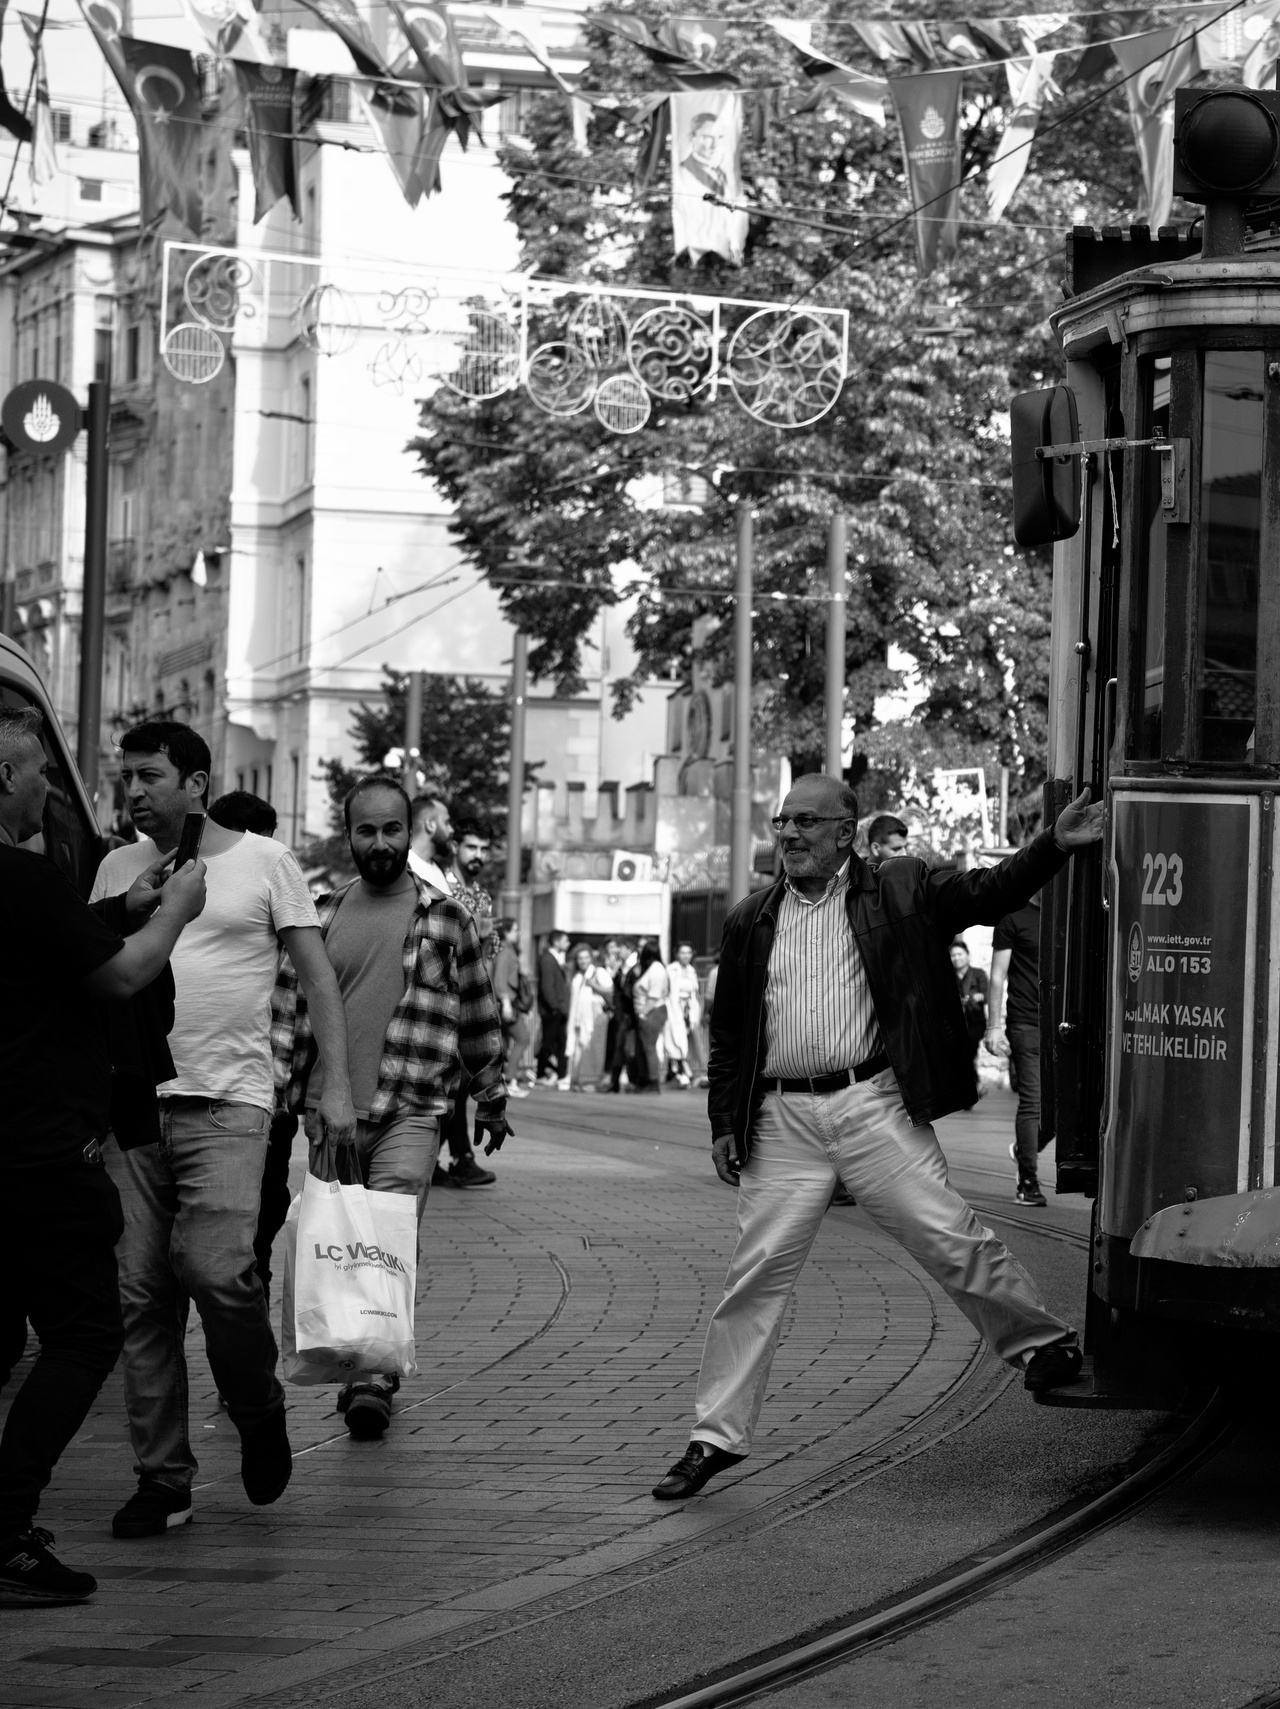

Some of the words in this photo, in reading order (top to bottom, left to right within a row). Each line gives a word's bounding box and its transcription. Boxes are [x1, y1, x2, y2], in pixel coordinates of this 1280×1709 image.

[1141, 852, 1183, 906] 223
[1147, 934, 1212, 946] www.iett.gov.tr
[1146, 955, 1175, 973] ALO
[1180, 956, 1211, 974] 153
[1173, 1004, 1226, 1028] YASAK
[1122, 1031, 1131, 1053] VE
[1133, 1031, 1227, 1061] TEHLİKELİDİR
[314, 1243, 343, 1262] LC
